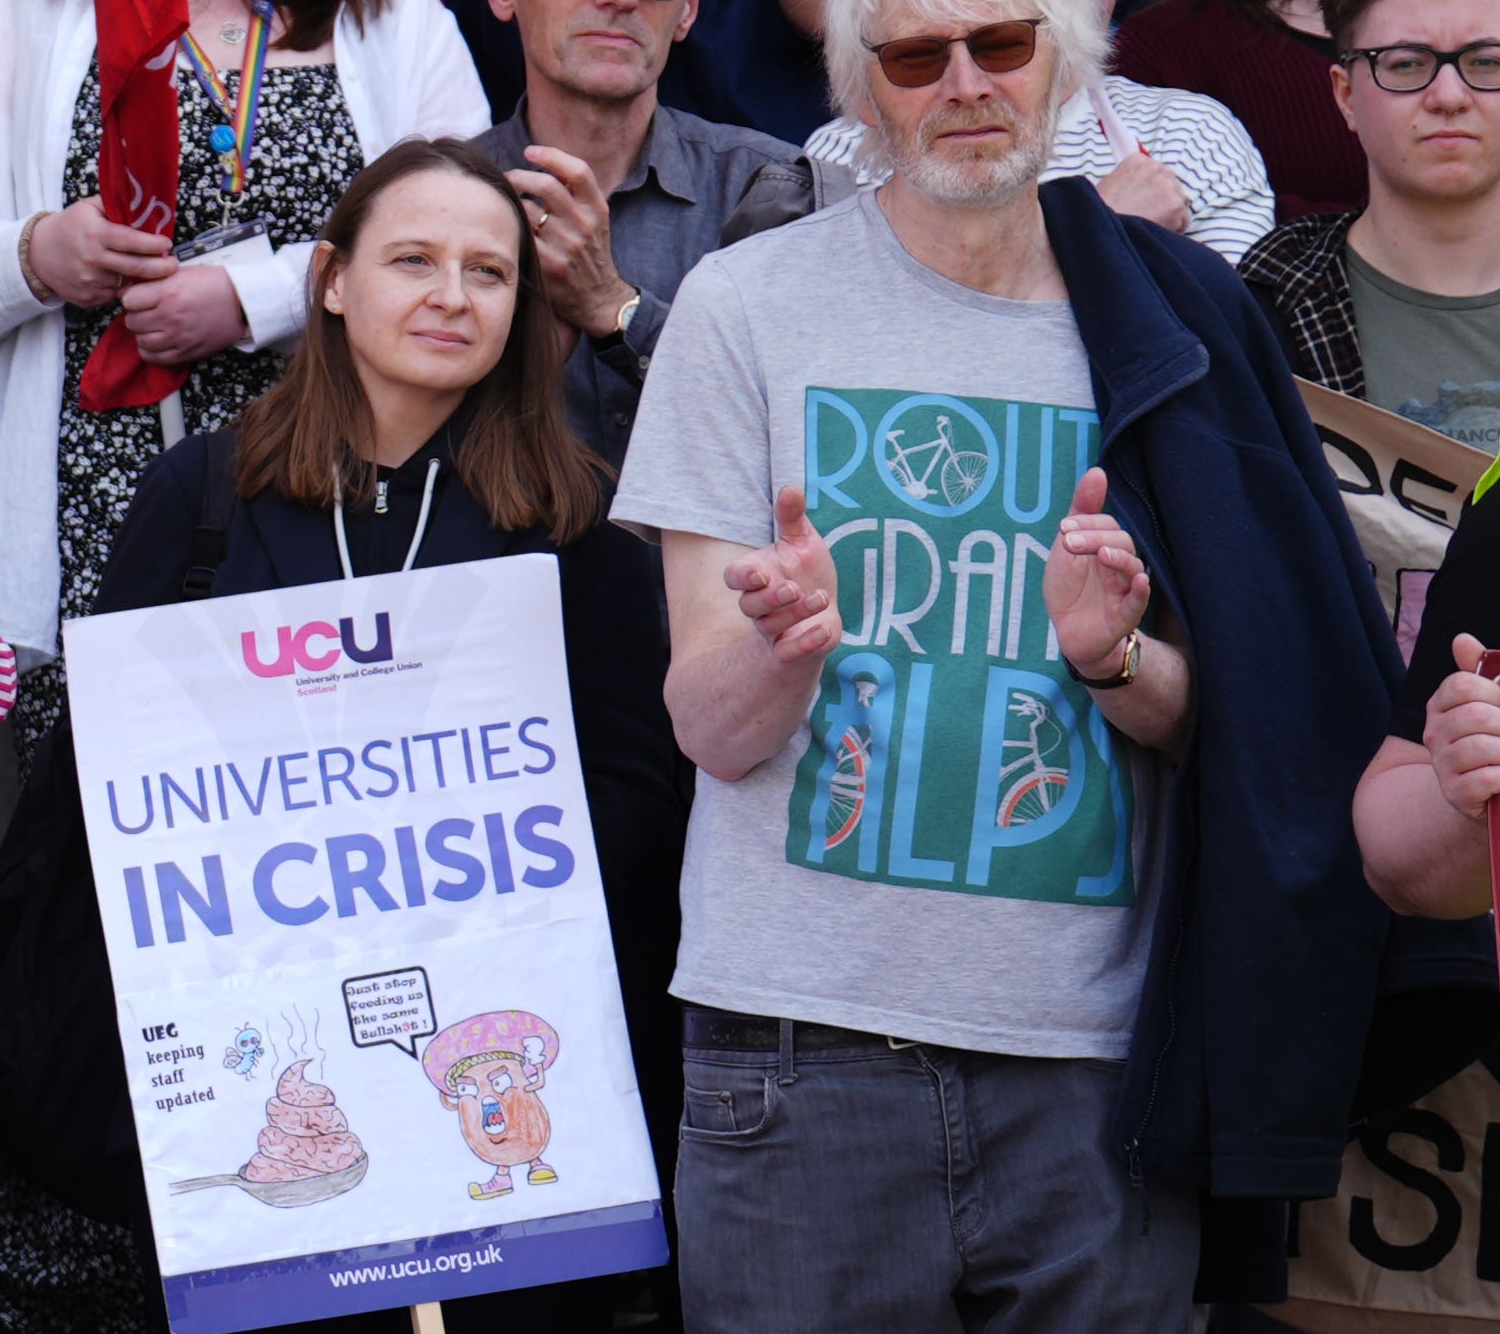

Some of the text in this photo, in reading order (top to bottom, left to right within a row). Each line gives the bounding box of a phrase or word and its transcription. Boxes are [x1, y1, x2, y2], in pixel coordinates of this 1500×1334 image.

[295, 661, 423, 686] University and College Union
[297, 684, 337, 697] Scotland
[106, 717, 556, 835] UNIVERSITIES
[123, 804, 576, 948] IN CRISIS
[384, 978, 416, 989] stop
[350, 991, 424, 1010] feeding us
[352, 1007, 418, 1025] the same
[142, 1022, 179, 1042] UEG
[146, 1043, 205, 1066] keeping
[151, 1068, 185, 1088] staff
[155, 1087, 216, 1112] updated
[329, 1246, 503, 1288] www.ucu.org.uk
